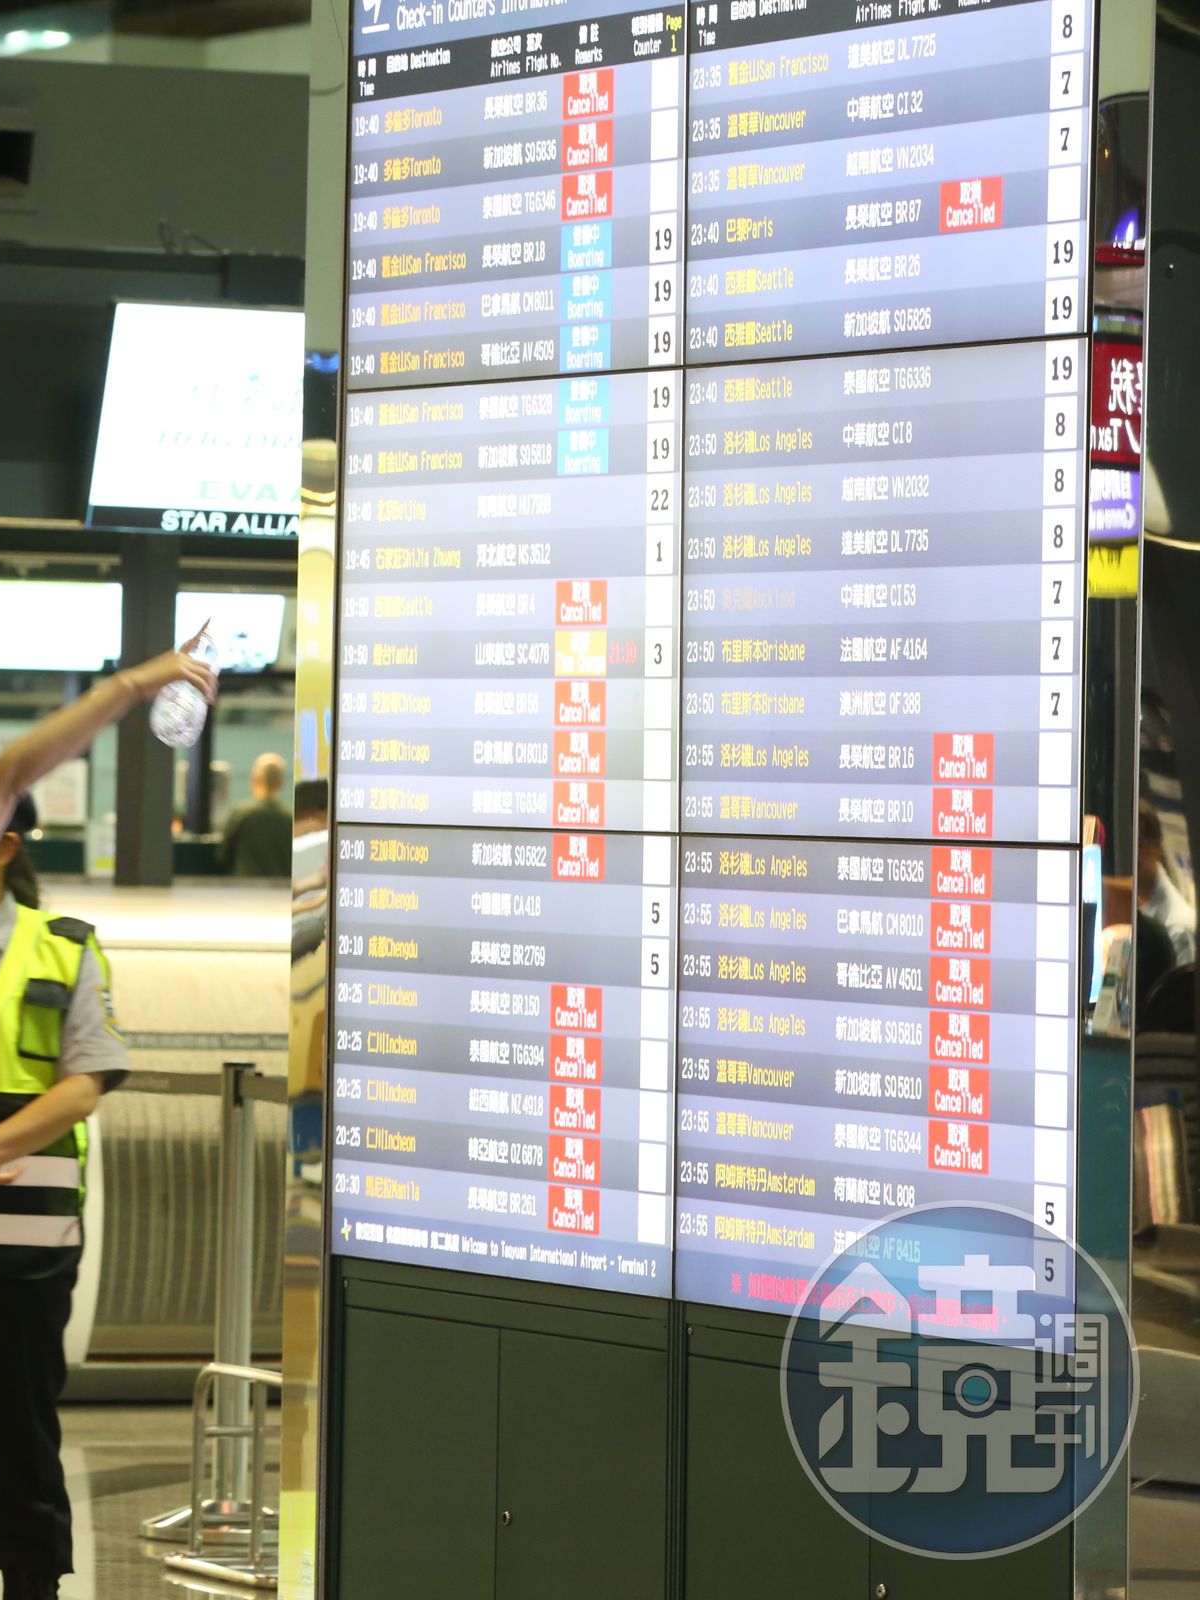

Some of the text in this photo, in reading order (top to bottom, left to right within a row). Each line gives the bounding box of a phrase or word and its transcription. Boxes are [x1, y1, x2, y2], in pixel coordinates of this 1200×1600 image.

[397, 1, 496, 31] Check-in Counters
[666, 13, 682, 31] Page
[633, 37, 661, 56] Counter
[670, 35, 677, 53] 1
[698, 30, 716, 47] Time
[410, 48, 450, 71] Destination
[575, 47, 603, 65] Remarks
[693, 65, 722, 88] 23:35
[1062, 15, 1073, 39] 8
[491, 53, 561, 78] Airlines Flight No.
[360, 81, 375, 96] Time
[567, 93, 608, 116] Cancelled
[692, 117, 721, 142] 23:35
[1061, 70, 1072, 95] 7
[355, 115, 379, 137] 19:40
[691, 168, 720, 193] 23:35
[1060, 127, 1070, 151] 7
[354, 164, 378, 184] 19:40
[353, 211, 377, 232] 19:40
[946, 201, 995, 227] Cancelled
[654, 228, 672, 250] 19
[691, 220, 720, 245] 23:40
[690, 274, 719, 298] 23:40
[1052, 239, 1074, 264] 19
[351, 279, 672, 328] 19:40 19
[1051, 296, 1072, 320] 19
[653, 331, 671, 353] 19
[689, 380, 717, 405] 23:40
[1051, 356, 1073, 380] 19
[652, 387, 670, 408] 19
[689, 433, 717, 457] 23:50
[1055, 412, 1065, 436] 8
[652, 438, 670, 459] 19
[688, 484, 716, 508] 23:50
[1054, 468, 1064, 492] 8
[651, 490, 669, 511] 22
[160, 510, 226, 533] STAR
[656, 541, 662, 562] 1
[687, 536, 716, 560] 23:50
[1053, 525, 1063, 548] 8
[687, 588, 715, 611] 23:50
[1052, 581, 1063, 605] 7
[343, 645, 368, 666] 19:50
[653, 643, 662, 665] 3
[686, 640, 715, 663] 23:50
[1051, 637, 1062, 660] 7
[686, 691, 714, 715] 23:50
[1051, 692, 1060, 716] 7
[340, 740, 365, 760] 20:00
[685, 744, 714, 767] 23:55
[938, 756, 987, 779] Cancelled
[557, 856, 599, 878] Cancelled
[685, 850, 712, 874] 23:55
[936, 872, 985, 894] Cancelled
[339, 888, 660, 924] 20:10 5
[338, 935, 363, 956] 20:10
[651, 954, 660, 975] 5
[683, 953, 712, 978] 23:55
[337, 982, 363, 1002] 20:25
[935, 983, 984, 1006] Cancelled
[555, 1006, 597, 1030] Cancelled
[337, 1031, 362, 1051] 20:25
[681, 1057, 710, 1082] 23:55
[336, 1079, 362, 1100] 20:25
[336, 1126, 360, 1148] 20:25
[934, 1144, 983, 1171] Cancelled
[335, 1175, 360, 1195] 20:30
[680, 1161, 709, 1185] 23:55
[1044, 1202, 1055, 1227] 5
[552, 1208, 594, 1232] Cancelled
[679, 1213, 1055, 1282] 23:55 5
[651, 1258, 656, 1278] 2
